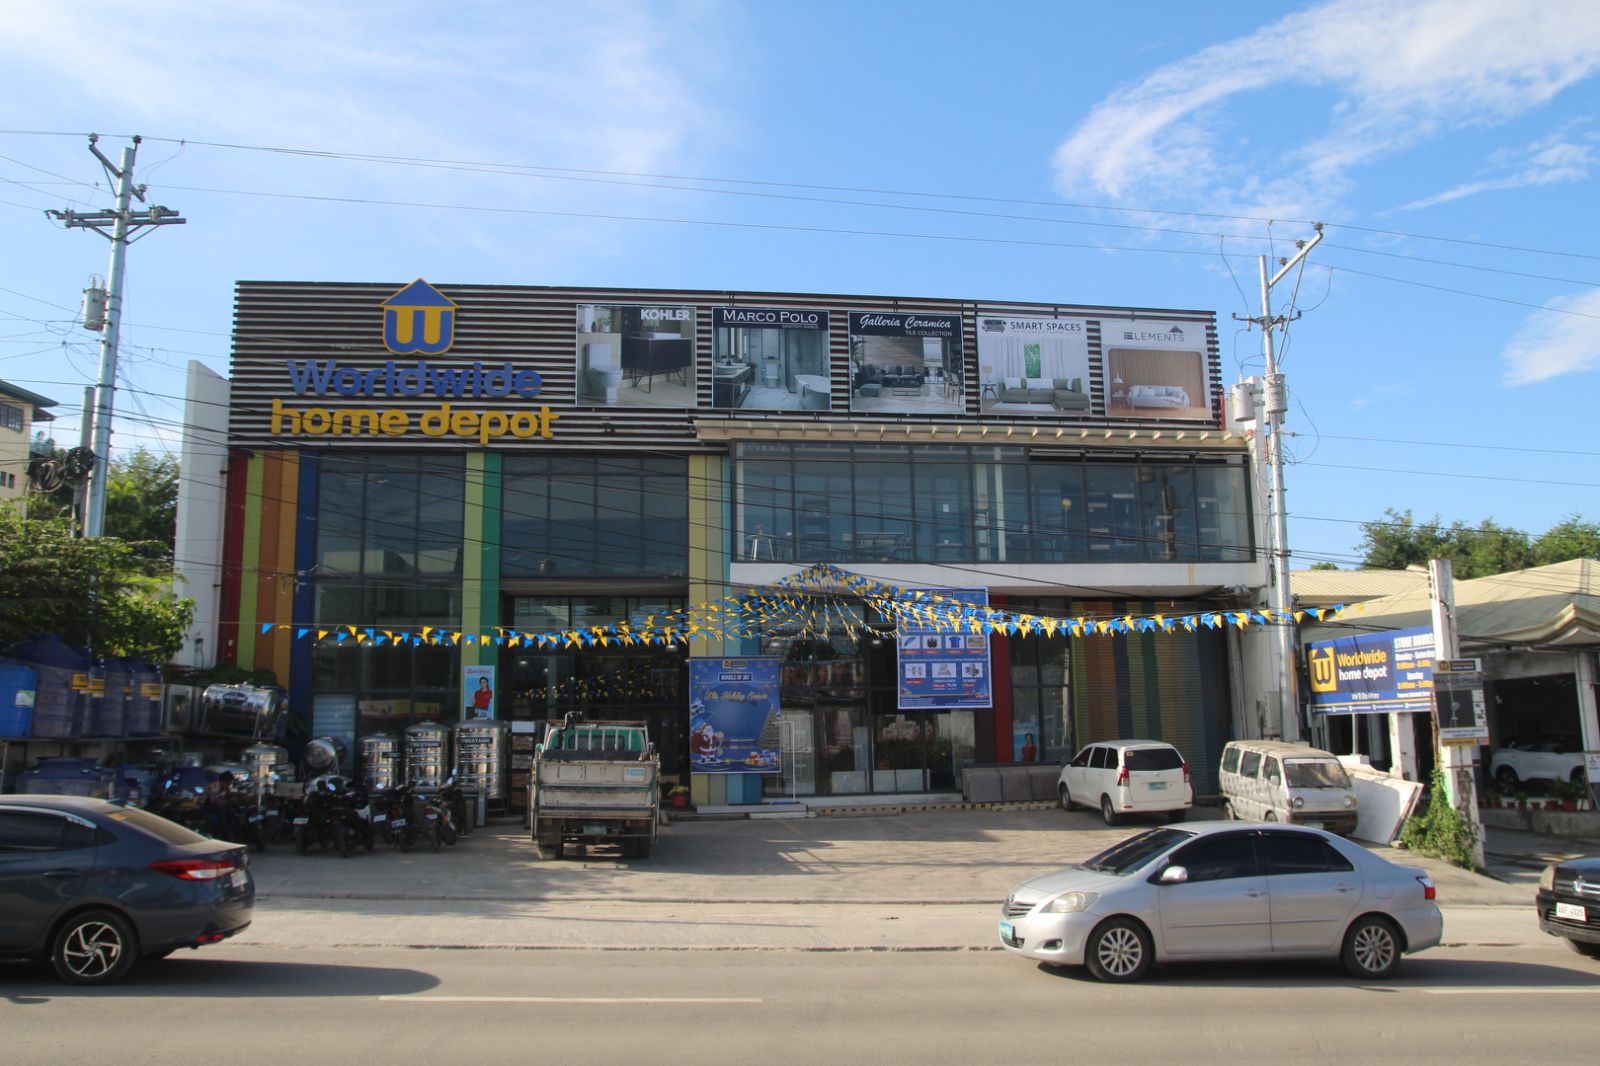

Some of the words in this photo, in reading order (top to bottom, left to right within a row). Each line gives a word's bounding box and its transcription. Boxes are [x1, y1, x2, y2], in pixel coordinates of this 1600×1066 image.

[640, 308, 690, 321] KOHLER
[723, 309, 776, 322] MARCO
[780, 311, 819, 323] POLO
[860, 314, 901, 329] Galleria
[904, 316, 952, 329] Ceramica
[1010, 321, 1043, 331] SMART
[1046, 322, 1082, 332] SPACES
[1123, 332, 1185, 342] ELEMENTS
[287, 359, 542, 398] Worldwide
[271, 399, 409, 436] home
[420, 402, 560, 445] depot
[1337, 649, 1387, 667] Worldwide
[1338, 669, 1362, 681] home
[1362, 665, 1388, 681] depot
